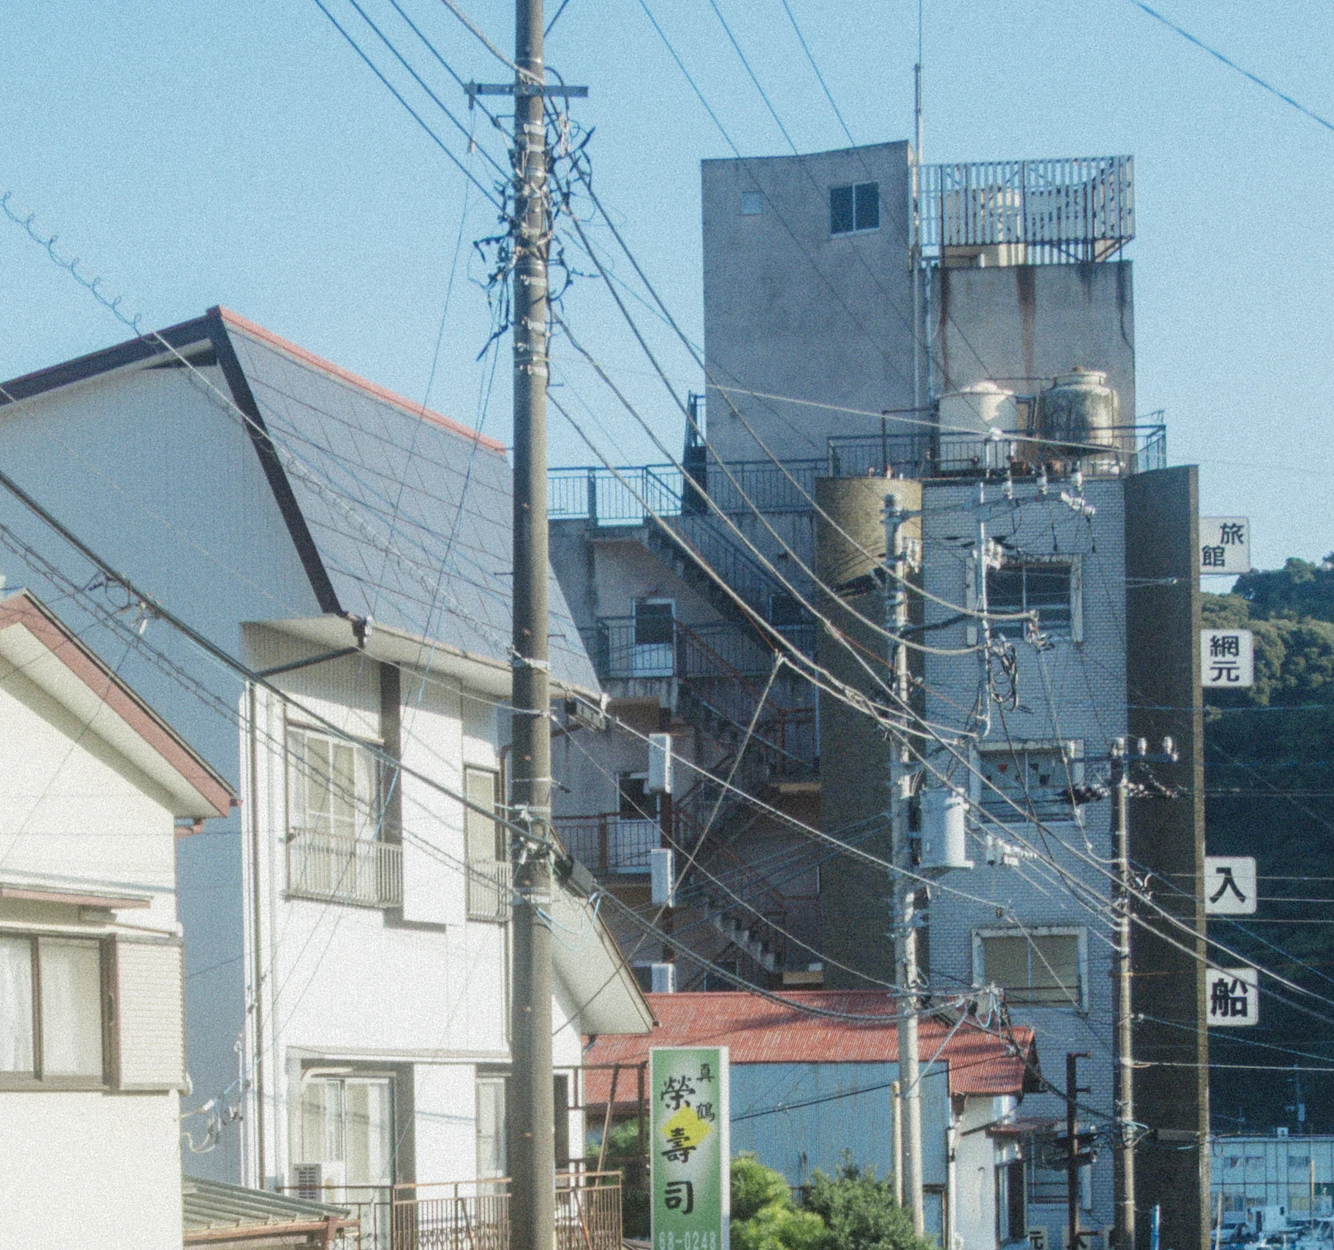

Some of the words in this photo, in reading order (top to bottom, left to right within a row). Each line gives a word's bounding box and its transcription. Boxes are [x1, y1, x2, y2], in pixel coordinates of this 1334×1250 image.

[1201, 523, 1245, 567] 旅館
[1209, 635, 1241, 683] 網元
[1209, 867, 1248, 1019] 入船
[696, 1062, 716, 1122] 真鶴
